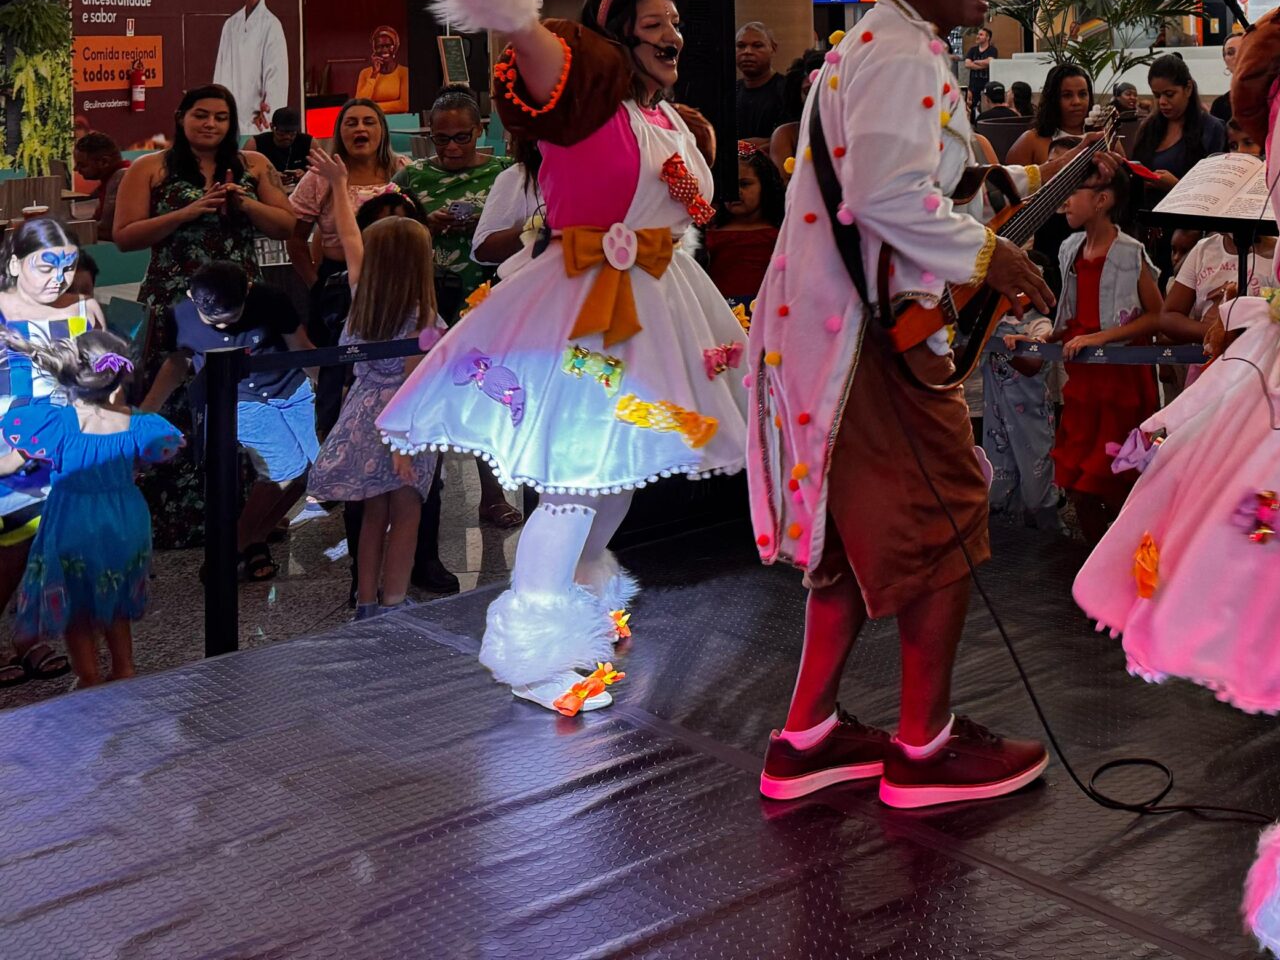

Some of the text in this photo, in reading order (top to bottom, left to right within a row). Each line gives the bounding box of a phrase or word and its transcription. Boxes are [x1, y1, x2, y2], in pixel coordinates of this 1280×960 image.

[82, 8, 117, 23] e sabor
[82, 45, 157, 62] Comida regional
[83, 64, 116, 82] todos
[118, 69, 131, 81] os
